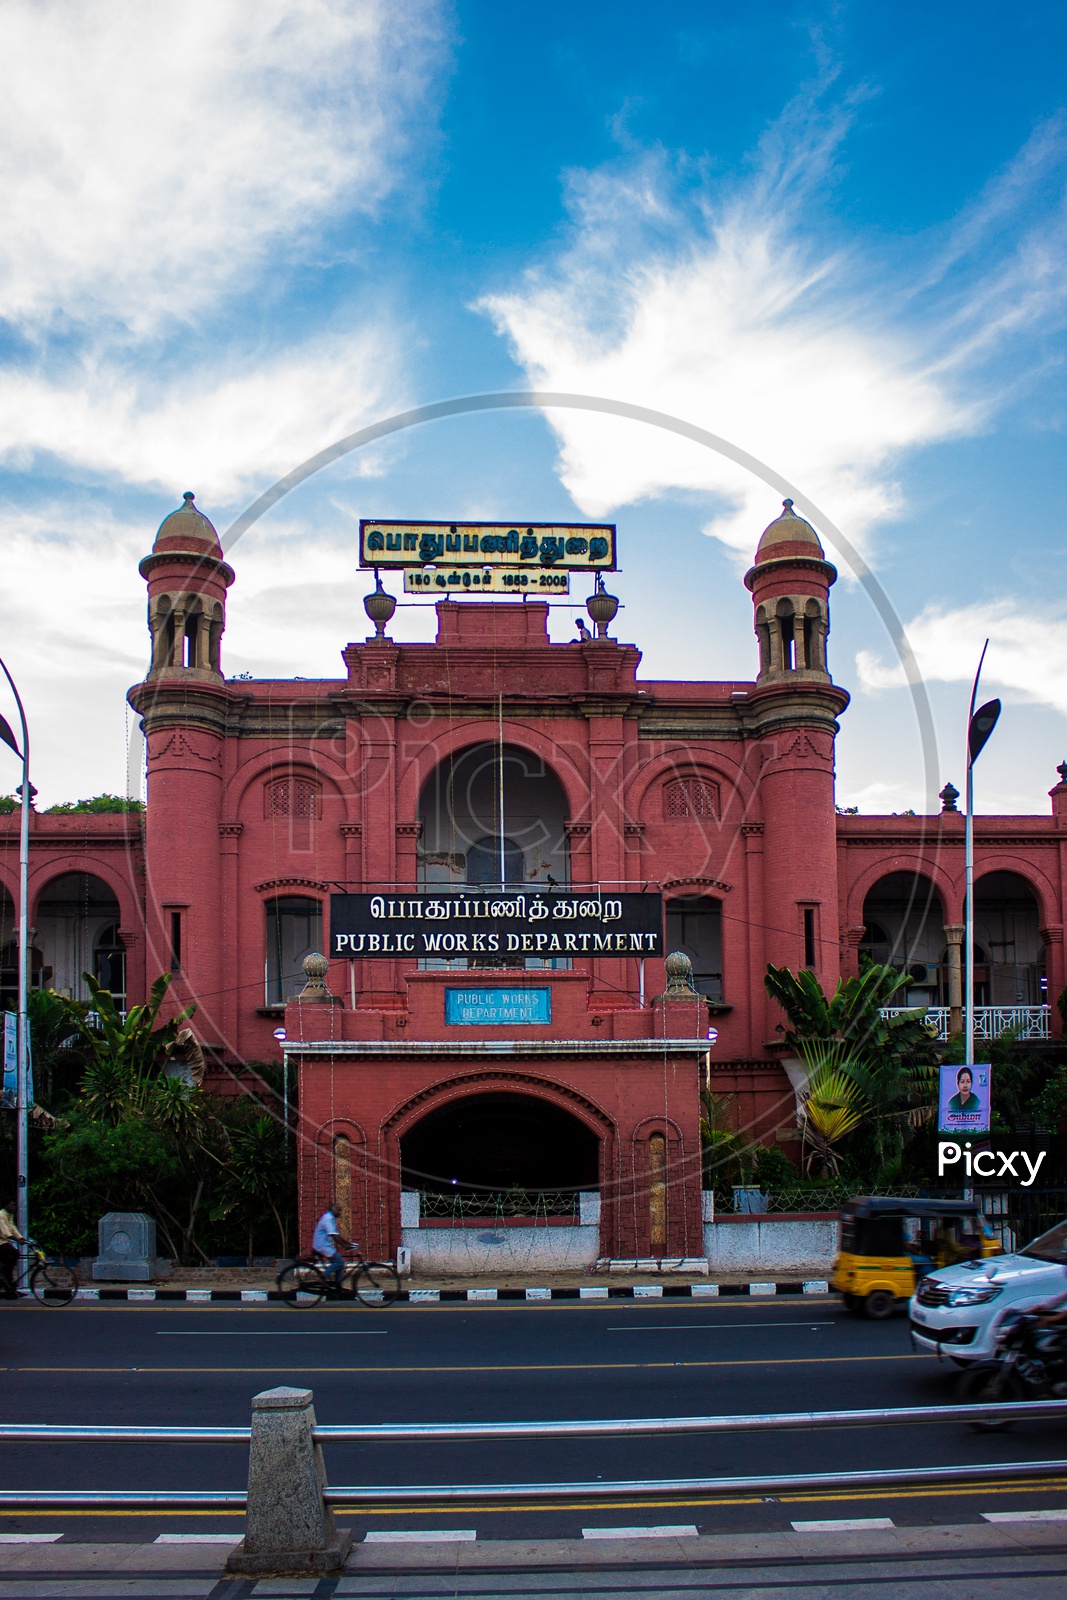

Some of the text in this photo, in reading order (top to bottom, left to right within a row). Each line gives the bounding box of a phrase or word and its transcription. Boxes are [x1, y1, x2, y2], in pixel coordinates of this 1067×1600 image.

[408, 574, 431, 586] 150
[335, 933, 658, 952] PUBLIC WORKS DEPARTMENT
[457, 993, 539, 1005] PUBLIC WORKS
[462, 1007, 533, 1019] DEPARTMENT
[400, 1250, 406, 1265] 1
